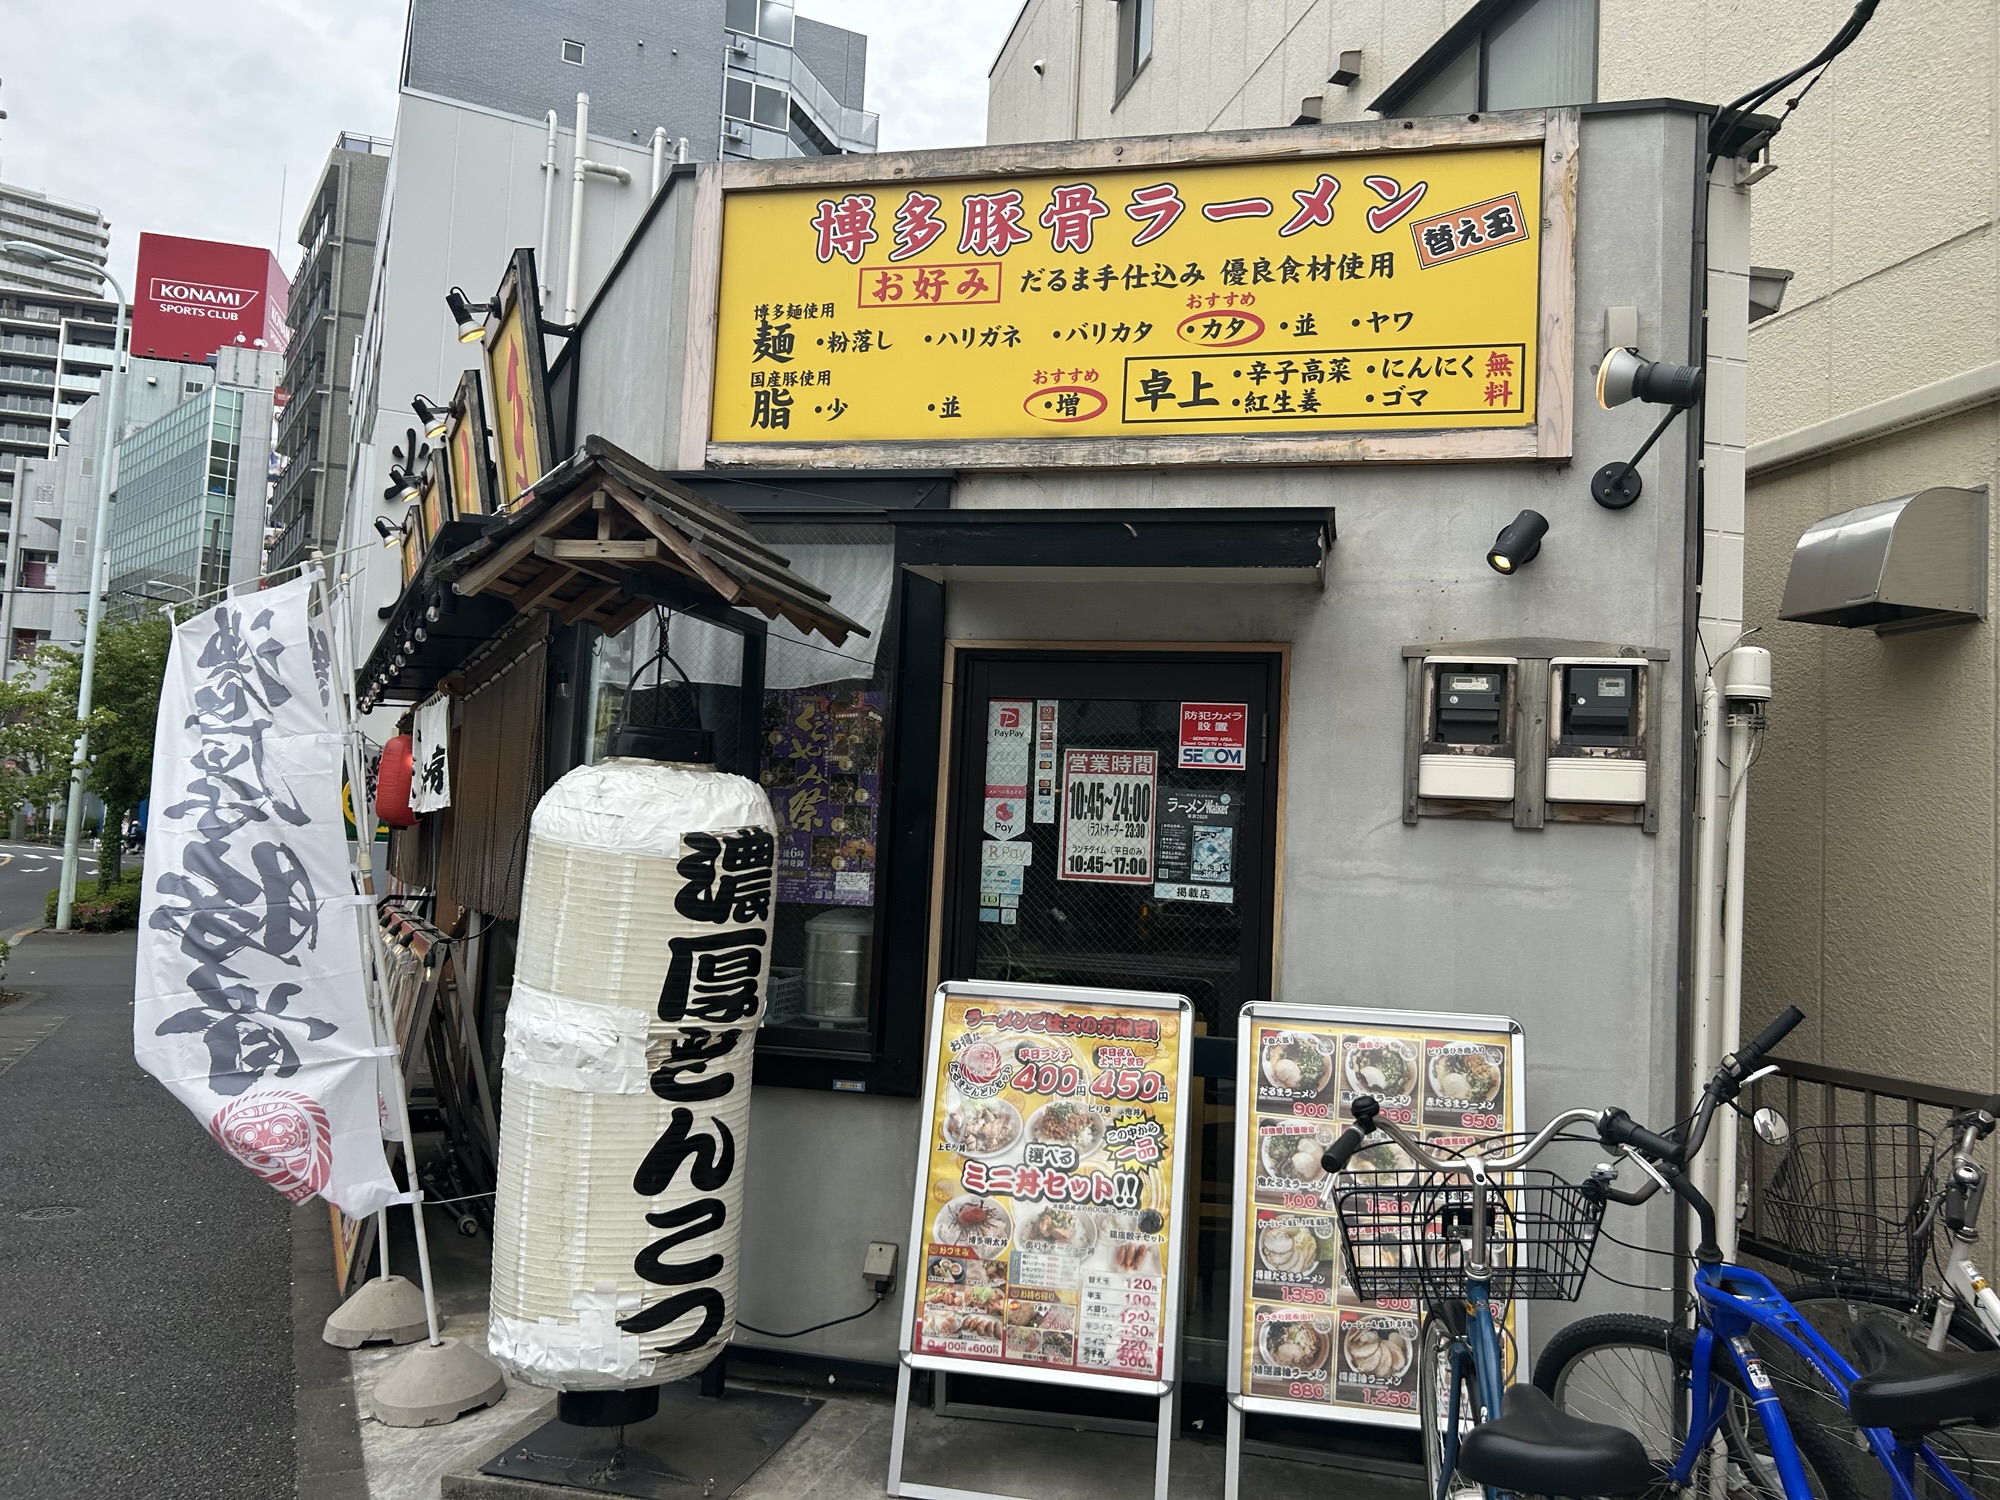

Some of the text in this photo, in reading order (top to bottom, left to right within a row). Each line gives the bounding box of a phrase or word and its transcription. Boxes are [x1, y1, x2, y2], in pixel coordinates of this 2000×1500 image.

[811, 174, 1428, 263] 博多豚骨ラーメン
[1421, 206, 1517, 256] 替え玉
[1020, 251, 1395, 293] だるま手仕込み 優良食材使用
[160, 283, 241, 306] KONAMI
[871, 268, 990, 303] お好み
[1187, 292, 1256, 309] おすすめ
[159, 303, 239, 321] SPORTS CLUB
[753, 302, 835, 321] 博多麺使用
[751, 321, 795, 364] 麺
[750, 370, 831, 388] 国産豚使用
[1032, 368, 1100, 385] おすすめ
[1483, 351, 1514, 408] 無料
[1134, 368, 1220, 411] 卓上
[750, 388, 795, 430] 脂
[1184, 711, 1243, 720] 防犯カメラ
[994, 729, 1025, 738] PayPay
[1198, 722, 1228, 731] 設置
[1068, 754, 1153, 774] 営業時間
[1183, 748, 1241, 764] SECOM
[788, 703, 828, 832] くらやみ祭
[1069, 781, 1151, 823] 10:45～24:00
[1167, 797, 1230, 815] ラーメンWalker
[994, 822, 1014, 834] Pay
[1002, 846, 1026, 862] Pay
[1072, 845, 1106, 855] ランチタイム
[1068, 855, 1148, 875] 10:45～17:00
[1176, 887, 1211, 899] 掲載店
[950, 1032, 981, 1052] お得な
[1019, 1048, 1072, 1062] 平日ランチ
[616, 828, 774, 1354] 濃厚とんこつ
[1259, 1086, 1317, 1098] だるまラーメン
[1293, 1102, 1328, 1117] 900
[1461, 1113, 1497, 1128] 950
[1107, 1122, 1159, 1143] この中から
[937, 1143, 966, 1152] 上モツ丼
[1027, 1146, 1076, 1166] 選べる
[1117, 1137, 1158, 1159] 一品
[1282, 1193, 1321, 1208] 1,00
[968, 1236, 1009, 1248] 博多明太丼
[939, 1246, 970, 1257] おつまみ
[1088, 1276, 1110, 1285] 替え玉
[1020, 1290, 1056, 1300] お持ち帰り
[1087, 1291, 1102, 1300] 半玉
[1281, 1286, 1326, 1304] 1,350
[1086, 1305, 1108, 1313] 大盛り
[1085, 1322, 1113, 1331] 半ライス
[1085, 1337, 1106, 1346] ライス
[1289, 1382, 1326, 1400] 880
[1363, 1388, 1412, 1408] 1,250
